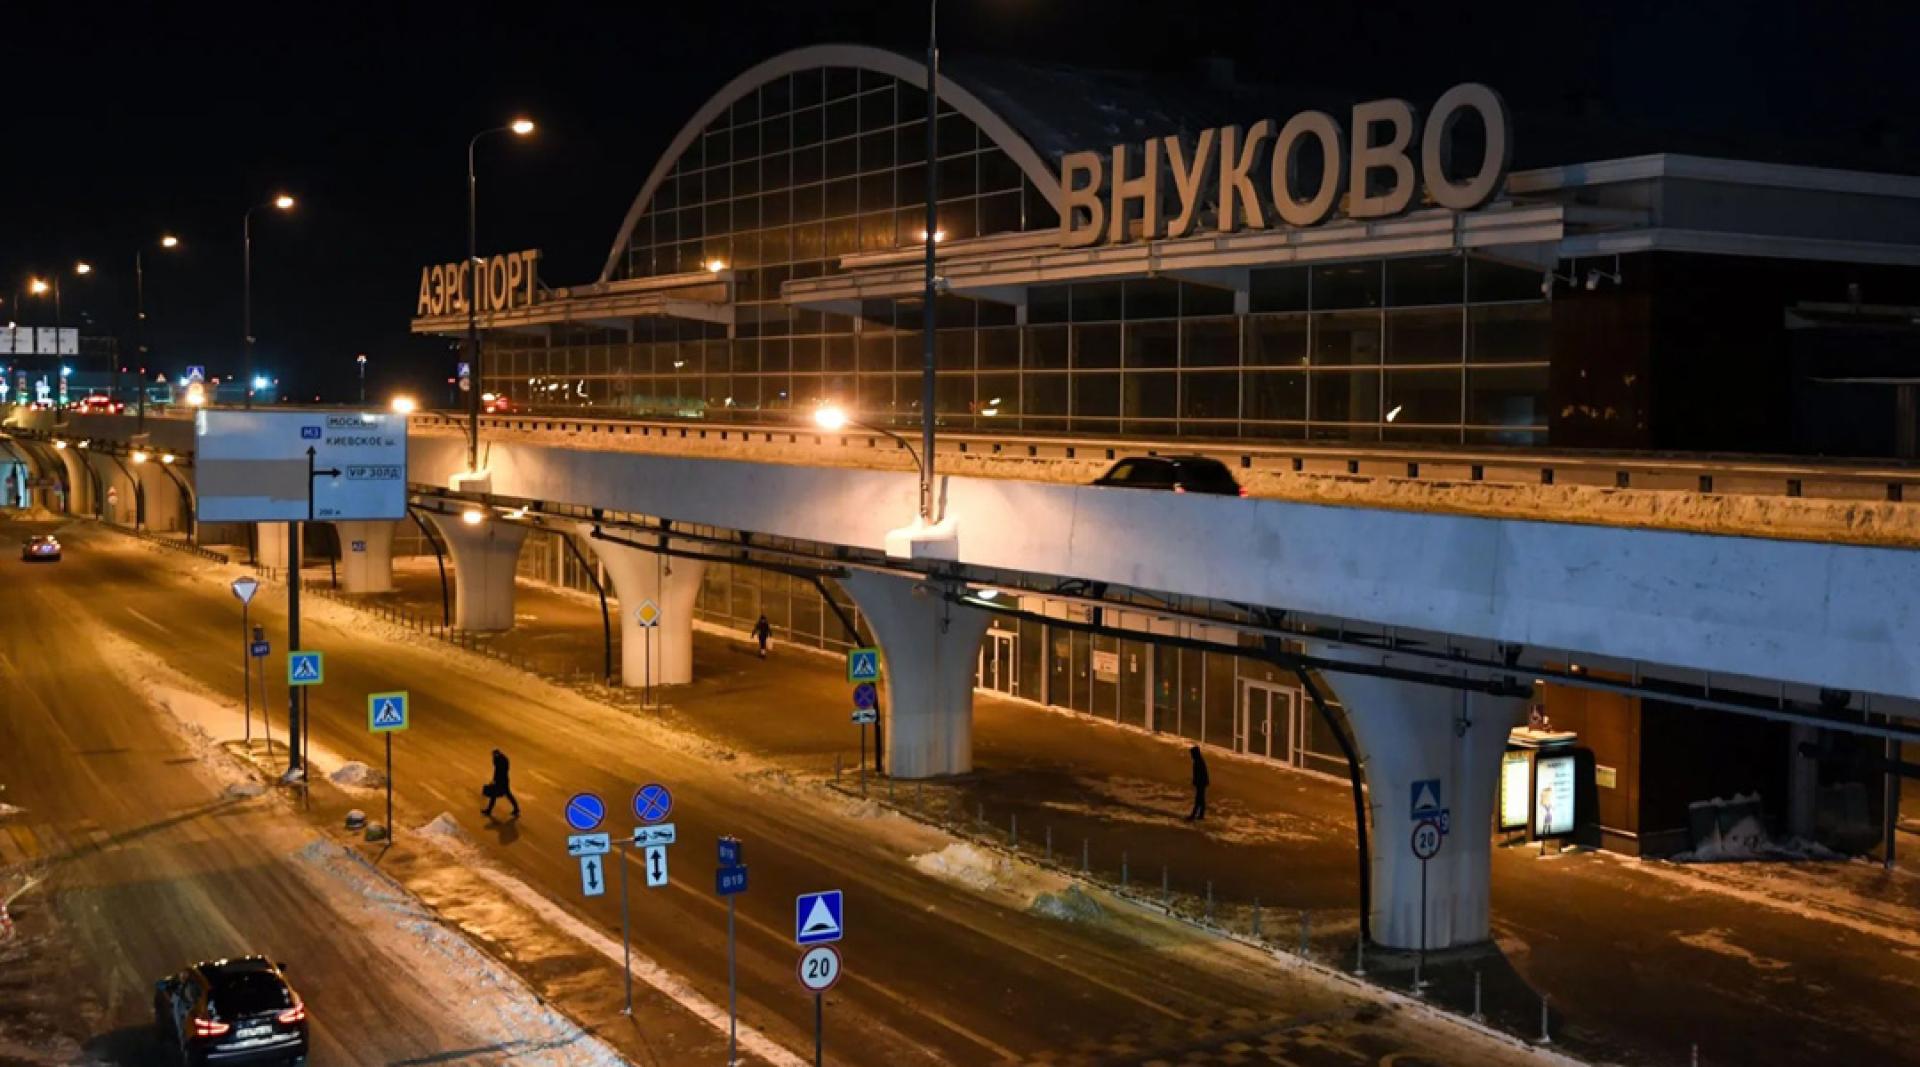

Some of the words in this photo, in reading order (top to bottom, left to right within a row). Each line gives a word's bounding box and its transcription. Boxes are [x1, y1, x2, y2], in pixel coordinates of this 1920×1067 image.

[1060, 82, 1508, 248] ВНУКОВО
[1420, 832, 1435, 849] 20
[808, 957, 830, 979] 20
